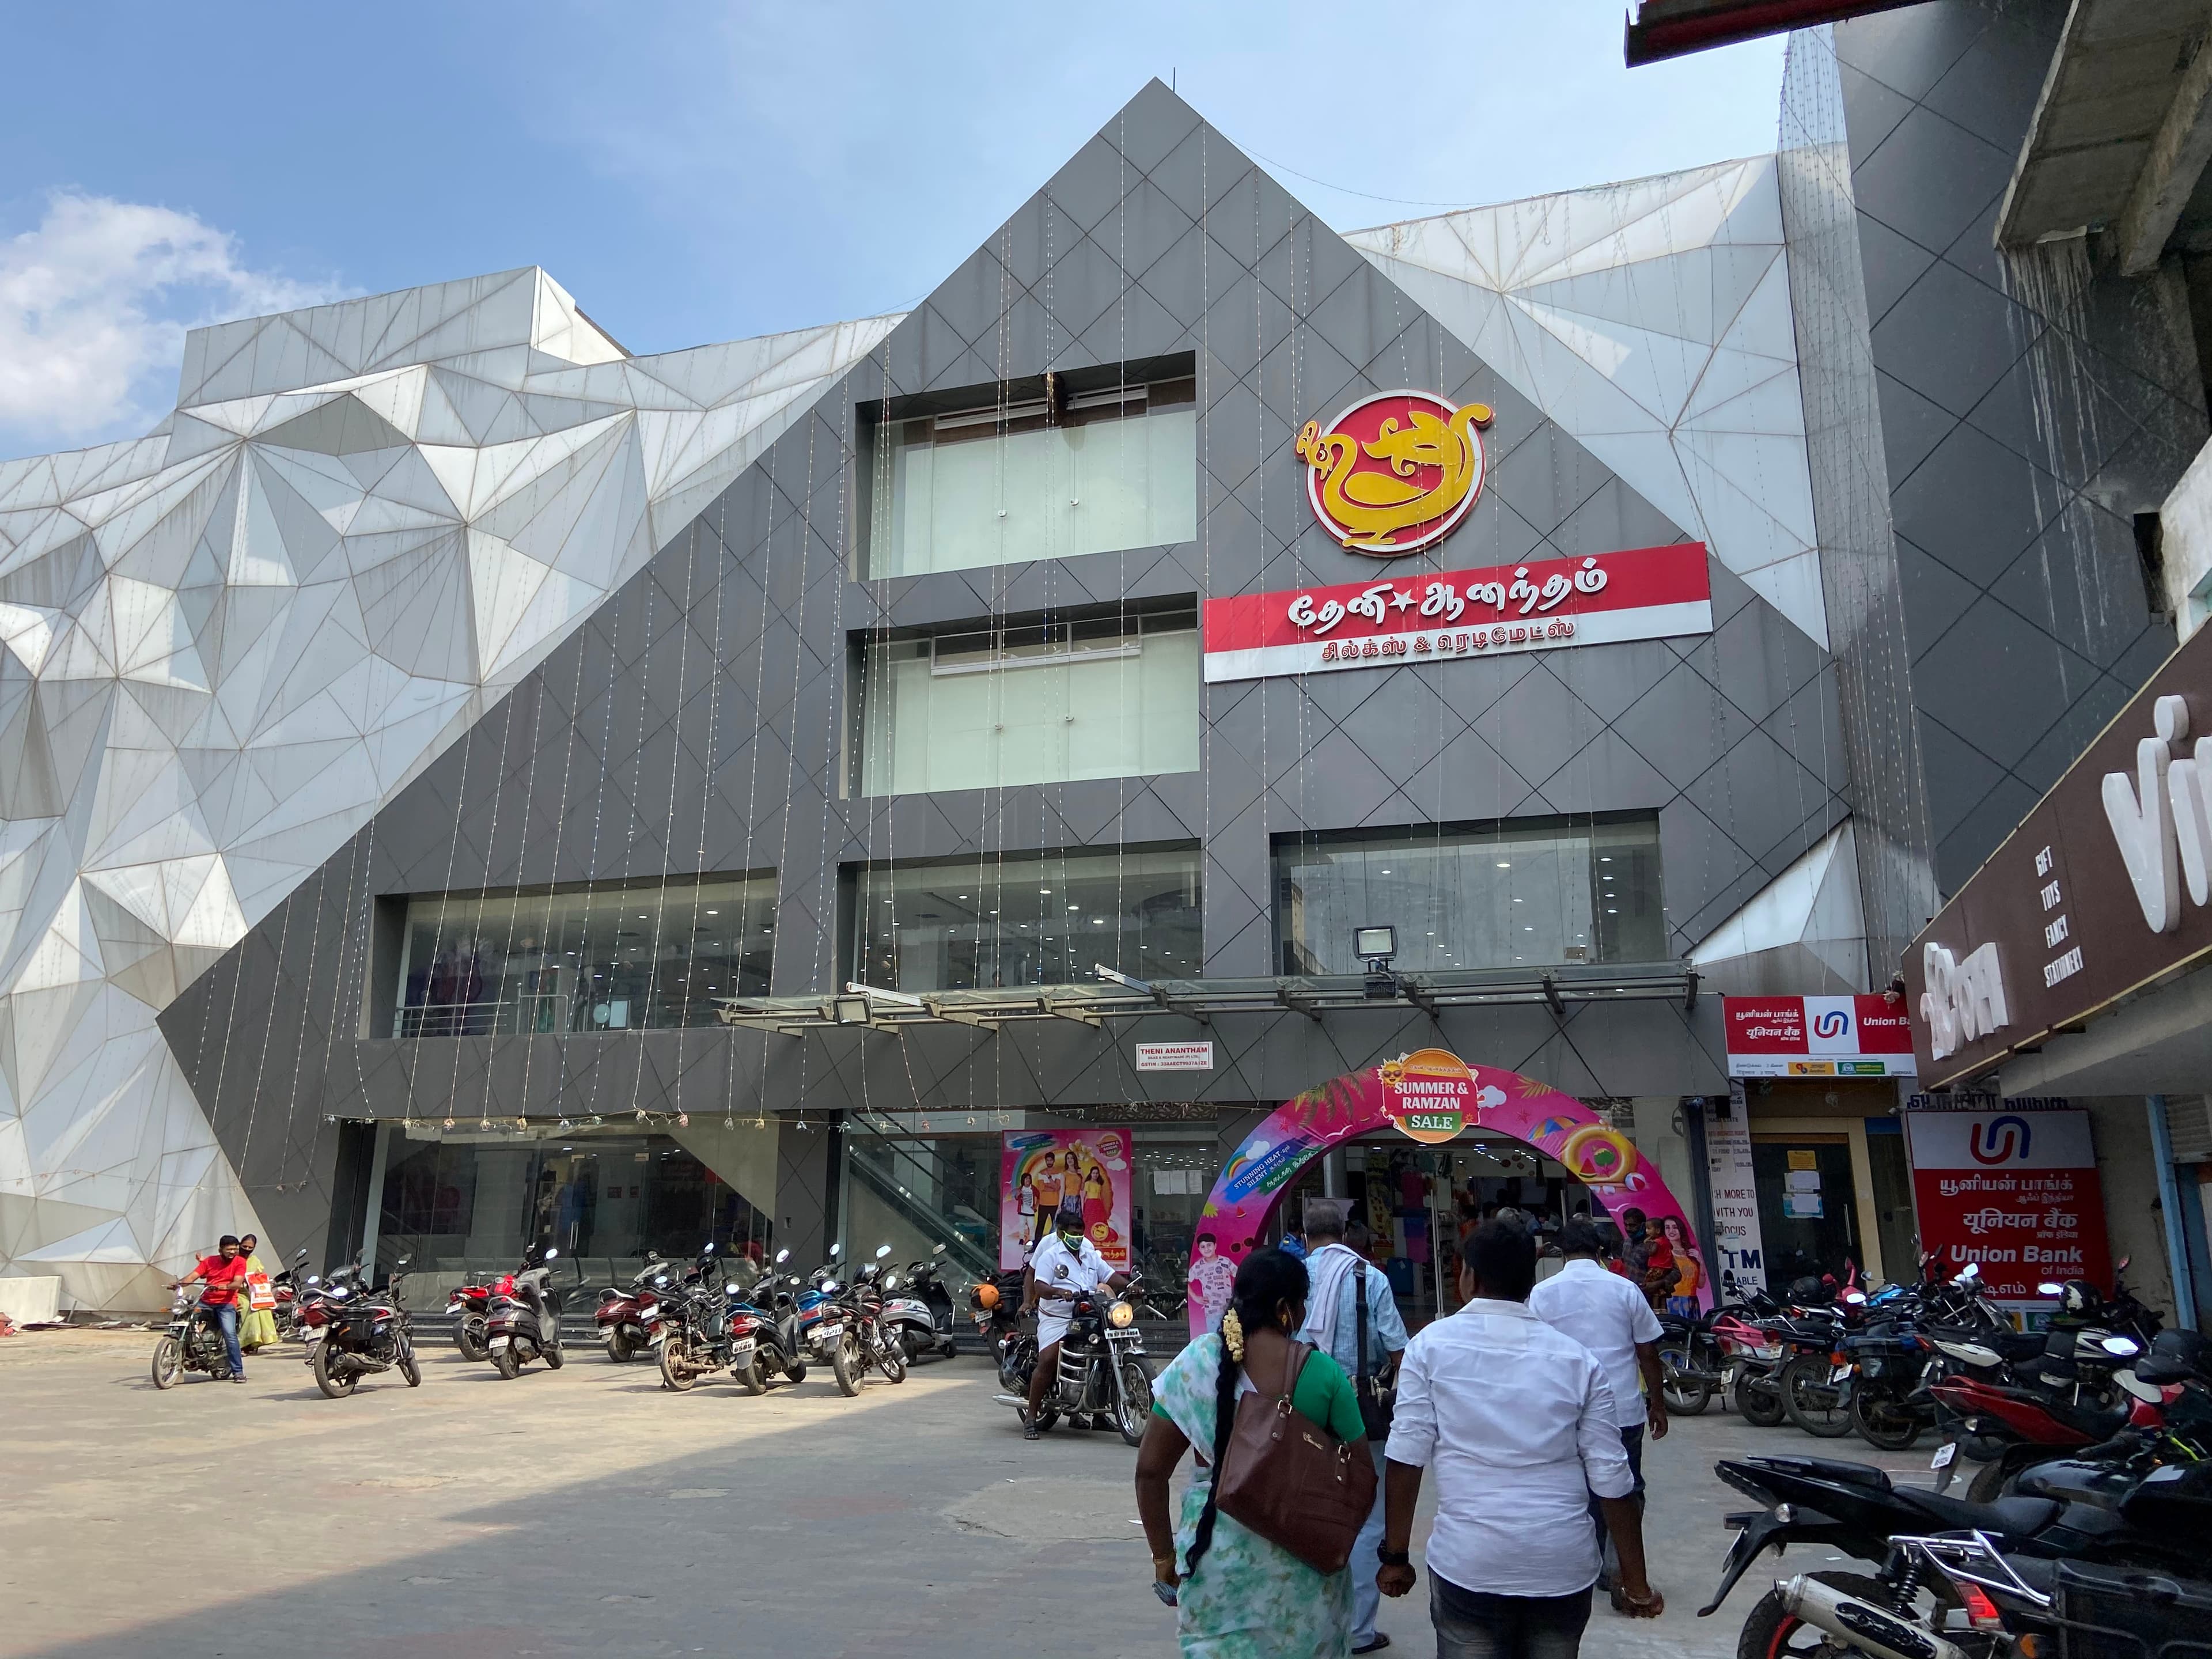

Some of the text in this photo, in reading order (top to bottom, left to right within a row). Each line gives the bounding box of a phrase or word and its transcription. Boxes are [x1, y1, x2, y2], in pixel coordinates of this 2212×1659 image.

[1288, 557, 1608, 635] தேனி ஆனந்தம்
[1321, 617, 1575, 661] சில்க்ஸ் & ரெடிமேட்ஸ்
[2035, 846, 2054, 877] GIFT
[2040, 880, 2061, 911] TOYS
[2044, 914, 2069, 949] FANCY
[2044, 945, 2084, 988] STATIONERY
[1863, 1017, 1896, 1025] Union
[1395, 1082, 1468, 1094] SUMMER &
[1403, 1097, 1460, 1109] RAMZAN
[1411, 1115, 1453, 1130] SALE
[1234, 1164, 1265, 1190] STUNNING
[1247, 1169, 1268, 1188] SILENT
[1940, 1173, 2017, 1196] யூனியன்
[1724, 1189, 1746, 1199] MORE
[1747, 1189, 1755, 1199] TO
[1737, 1207, 1753, 1217] YOU
[1963, 1207, 2078, 1234] यूनियन बैंक
[1724, 1226, 1746, 1236] OCUS
[1722, 1249, 1762, 1269] TM
[1950, 1245, 2083, 1263] Union Bank
[2041, 1266, 2084, 1275] of India
